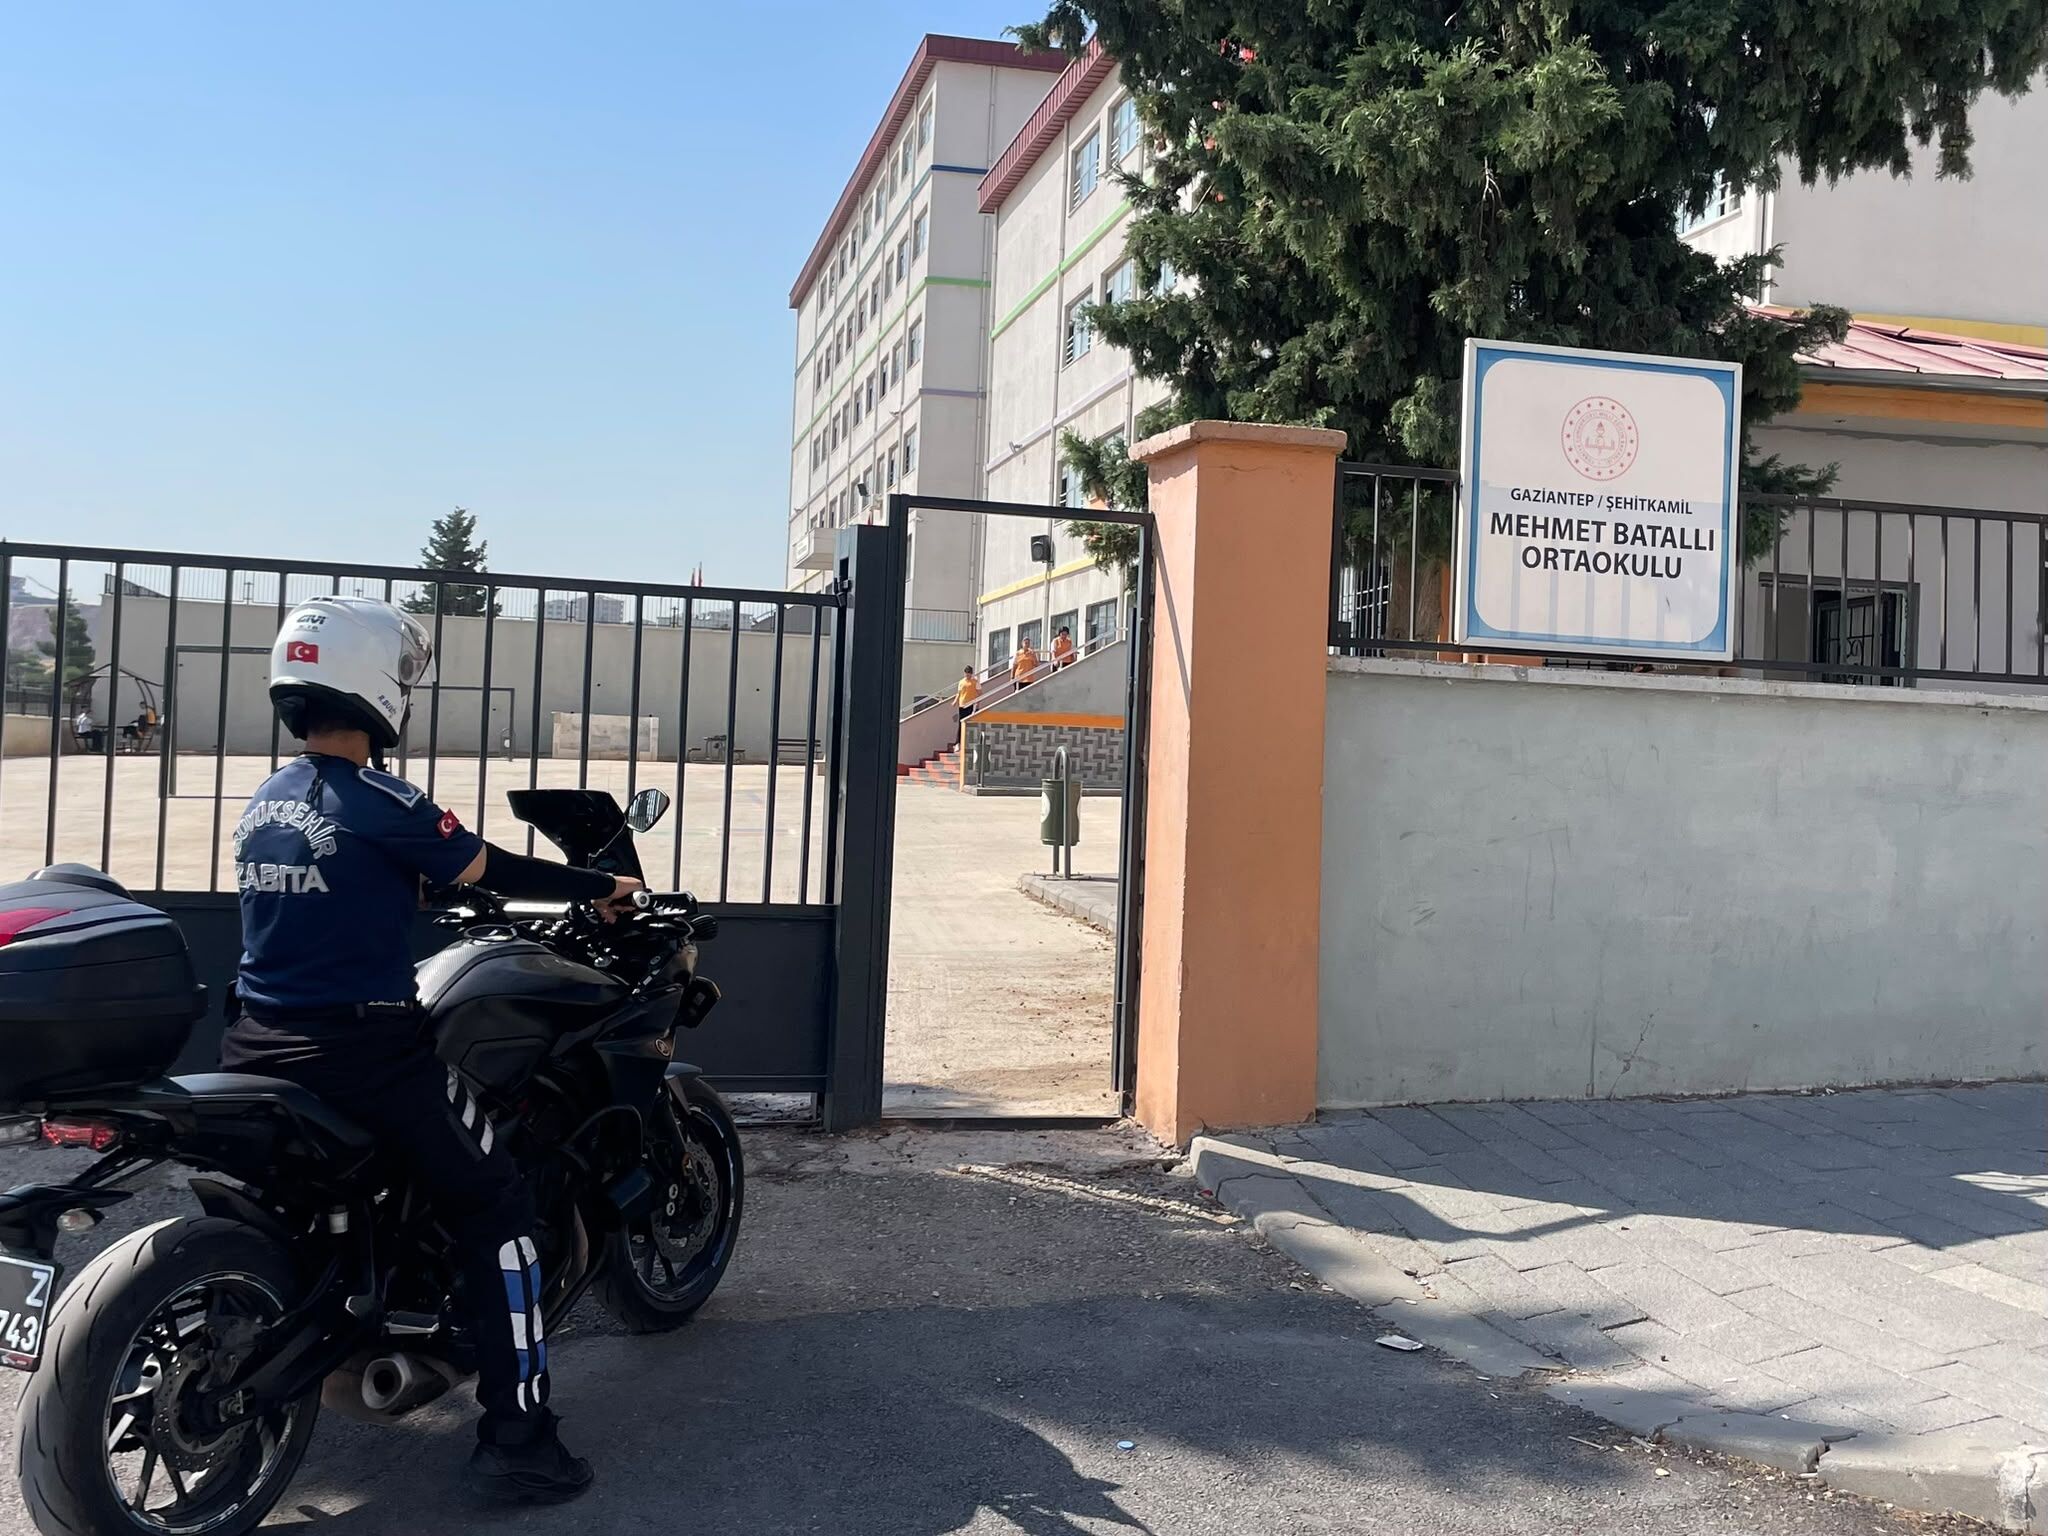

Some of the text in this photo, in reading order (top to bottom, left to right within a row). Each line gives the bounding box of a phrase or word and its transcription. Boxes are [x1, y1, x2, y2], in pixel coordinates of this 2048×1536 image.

[1510, 487, 1693, 515] GAZİANTEP / ŞEHİTKAMİL
[1490, 511, 1715, 551] MEHMET BATALLI
[1521, 545, 1682, 579] ORTAOKULU
[235, 862, 330, 894] ZABITA
[25, 1270, 50, 1308] Z
